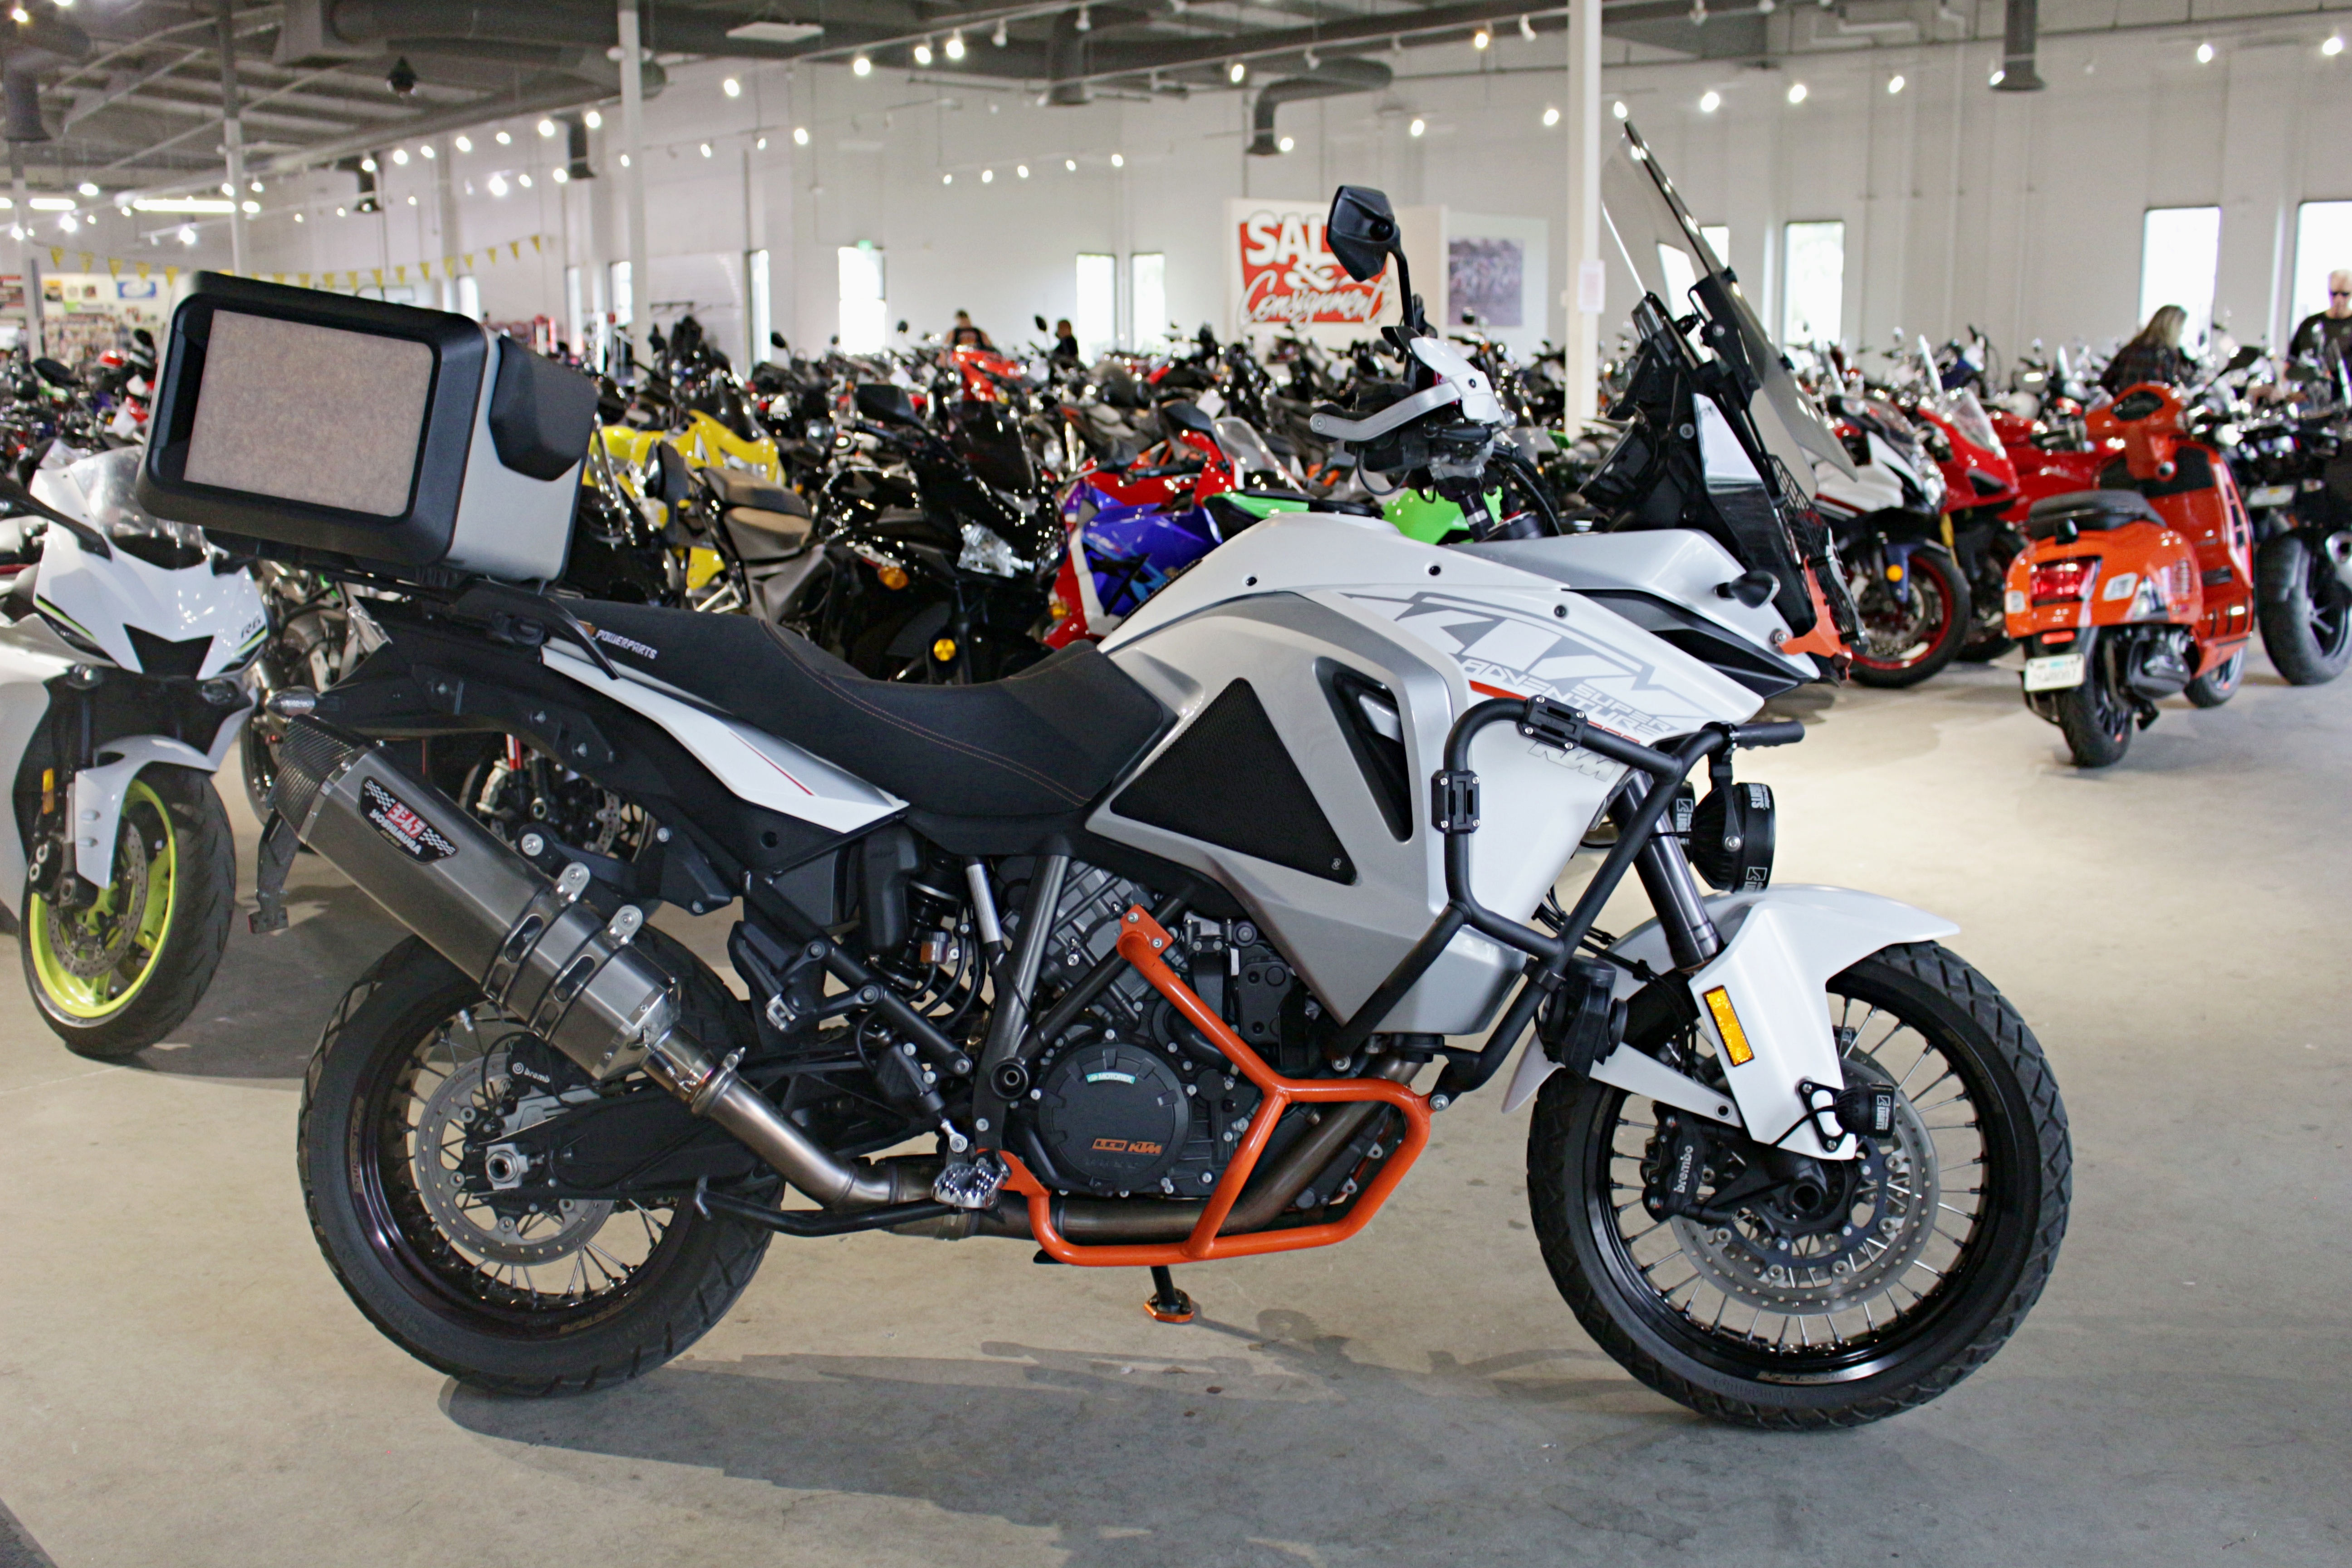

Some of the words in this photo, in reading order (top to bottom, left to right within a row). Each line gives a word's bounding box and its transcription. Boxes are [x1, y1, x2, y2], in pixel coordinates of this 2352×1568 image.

[1245, 210, 1342, 266] SAL
[1237, 270, 1392, 333] Consignment
[596, 629, 657, 659] POWERPARTS
[1464, 658, 1661, 736] ADVENTURE
[1571, 684, 1680, 732] SUPER
[369, 808, 422, 855] YOSHIMURA
[1098, 1072, 1133, 1083] MOTOREX
[1127, 1141, 1162, 1154] KTM
[1673, 1146, 1693, 1193] brembo
